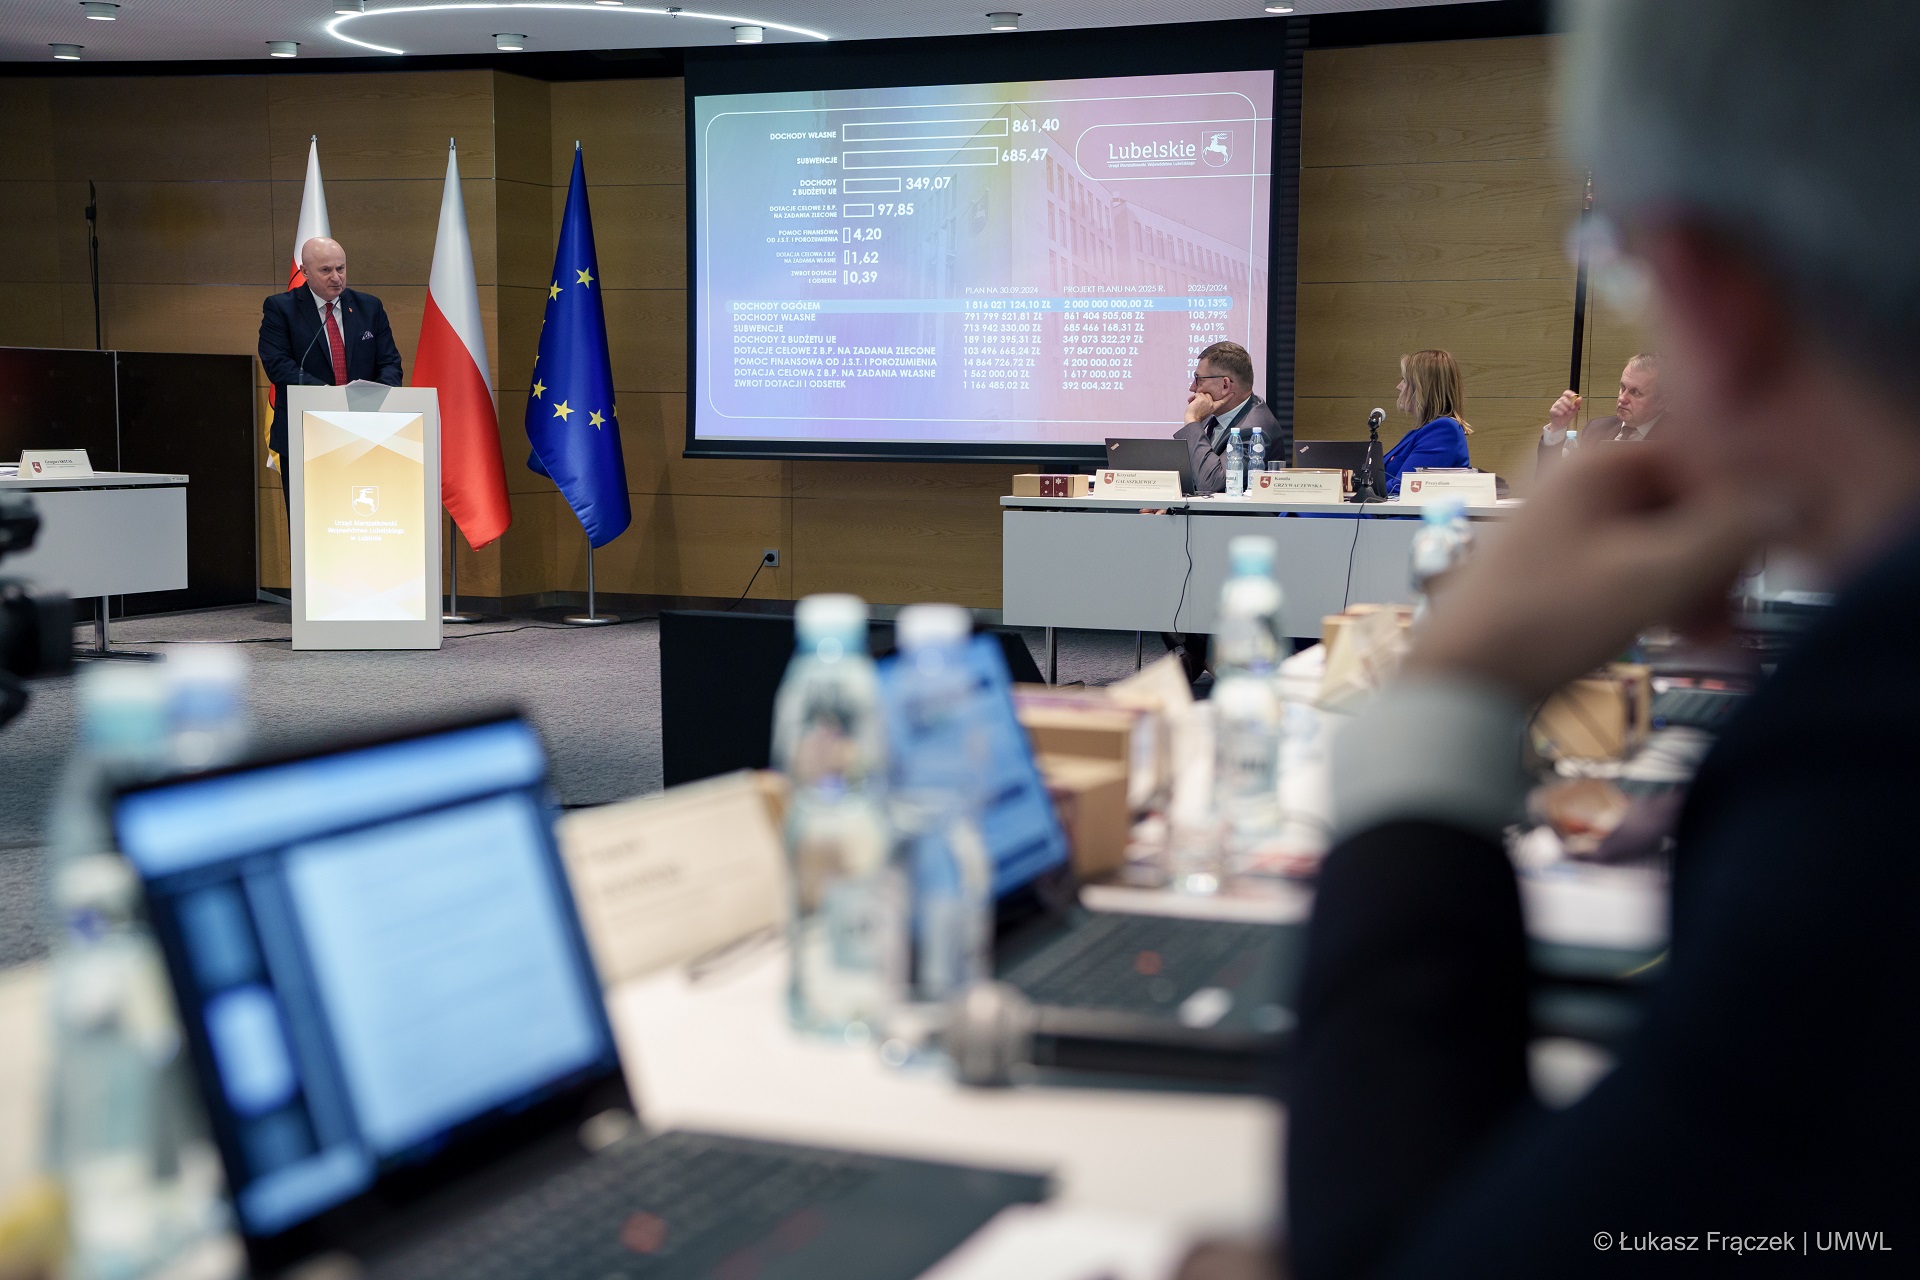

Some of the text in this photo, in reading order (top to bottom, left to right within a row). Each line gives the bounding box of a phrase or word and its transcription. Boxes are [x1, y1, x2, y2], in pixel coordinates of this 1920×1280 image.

[1012, 118, 1060, 134] 861,40
[770, 131, 837, 140] DOCHODY WŁASNE
[1108, 139, 1196, 160] Lubelskie
[796, 156, 838, 165] SUBWENCJE
[1001, 147, 1048, 164] 685,47
[800, 178, 837, 188] DOCHODY
[906, 176, 951, 192] 349,07
[798, 186, 827, 196] BUDŻETU
[877, 202, 914, 218] 97,85
[853, 227, 882, 242] 4,20
[851, 250, 879, 266] 1,62
[849, 270, 878, 285] 0,39
[1063, 285, 1096, 293] PROJEKT
[1138, 284, 1157, 293] 2025
[1158, 284, 1166, 292] R.
[1187, 284, 1228, 293] 2025/2024
[733, 300, 821, 311] DOCHODY OGÓŁEM
[972, 300, 989, 309] 816
[990, 300, 1006, 309] 021
[1010, 300, 1040, 310] 124,10
[1041, 300, 1051, 309] ZŁ
[1072, 300, 1089, 309] 000
[1091, 300, 1109, 309] 000
[1110, 299, 1142, 309] 000,00
[1143, 299, 1154, 308] ZŁ
[1187, 298, 1228, 308] 110,13%
[733, 313, 816, 322] DOCHODY WŁASNE
[965, 312, 1043, 322] 791 799 521,81 ZŁ
[1064, 311, 1145, 321] 861 404 505,08 ZŁ
[1188, 310, 1228, 320] 108,79%
[733, 324, 784, 333] SUBWENCJE
[964, 323, 1042, 333] 713 942 330,00 ZŁ
[1064, 322, 1145, 332] 685 466 168,31 ZŁ
[1190, 322, 1225, 332] 96,01%
[734, 335, 779, 344] DOCHODY
[788, 334, 824, 344] BUDŻETU
[826, 335, 837, 344] UE
[964, 335, 1042, 344] 189 189 395,31 ZŁ
[1062, 334, 1144, 344] 349 073 322,29 ZŁ
[1188, 334, 1227, 343] 184,51%
[734, 346, 773, 355] DOTACJE
[775, 346, 811, 355] CELOWE
[820, 346, 835, 355] B.P.
[837, 346, 851, 355] NA
[853, 346, 894, 355] ZADANIA
[895, 346, 936, 355] ZLECONE
[963, 346, 1041, 356] 103 496 665,24 ZŁ
[1063, 346, 1139, 356] 97 847 000,00 ZŁ
[734, 357, 768, 366] POMOC
[770, 357, 823, 366] FINANSOWA
[825, 358, 840, 366] OD
[841, 358, 862, 366] J.S.T.
[869, 358, 937, 366] POROZUMIENIA
[963, 358, 1035, 367] 14 864 726,72 ZŁ
[1071, 358, 1088, 367] 200
[1090, 358, 1121, 368] 000,00
[1123, 358, 1133, 367] ZŁ
[734, 368, 775, 376] DOTACJA
[777, 368, 815, 377] CELOWA
[824, 368, 839, 377] B.P.
[841, 369, 855, 377] NA
[856, 369, 898, 378] ZADANIA
[899, 369, 936, 378] WŁASNE
[970, 369, 987, 378] 562
[988, 369, 1018, 379] 000,00
[1020, 369, 1030, 378] ZŁ
[1070, 369, 1088, 378] 617
[1089, 369, 1120, 379] 000,00
[1122, 370, 1132, 379] ZŁ
[734, 379, 763, 388] ZWROT
[764, 379, 802, 388] DOTACJI
[809, 380, 846, 388] ODSETEK
[971, 381, 986, 389] 166
[988, 381, 1018, 390] 485,02
[1020, 381, 1030, 390] ZŁ
[1062, 381, 1124, 391] 392 004,32 ZŁ
